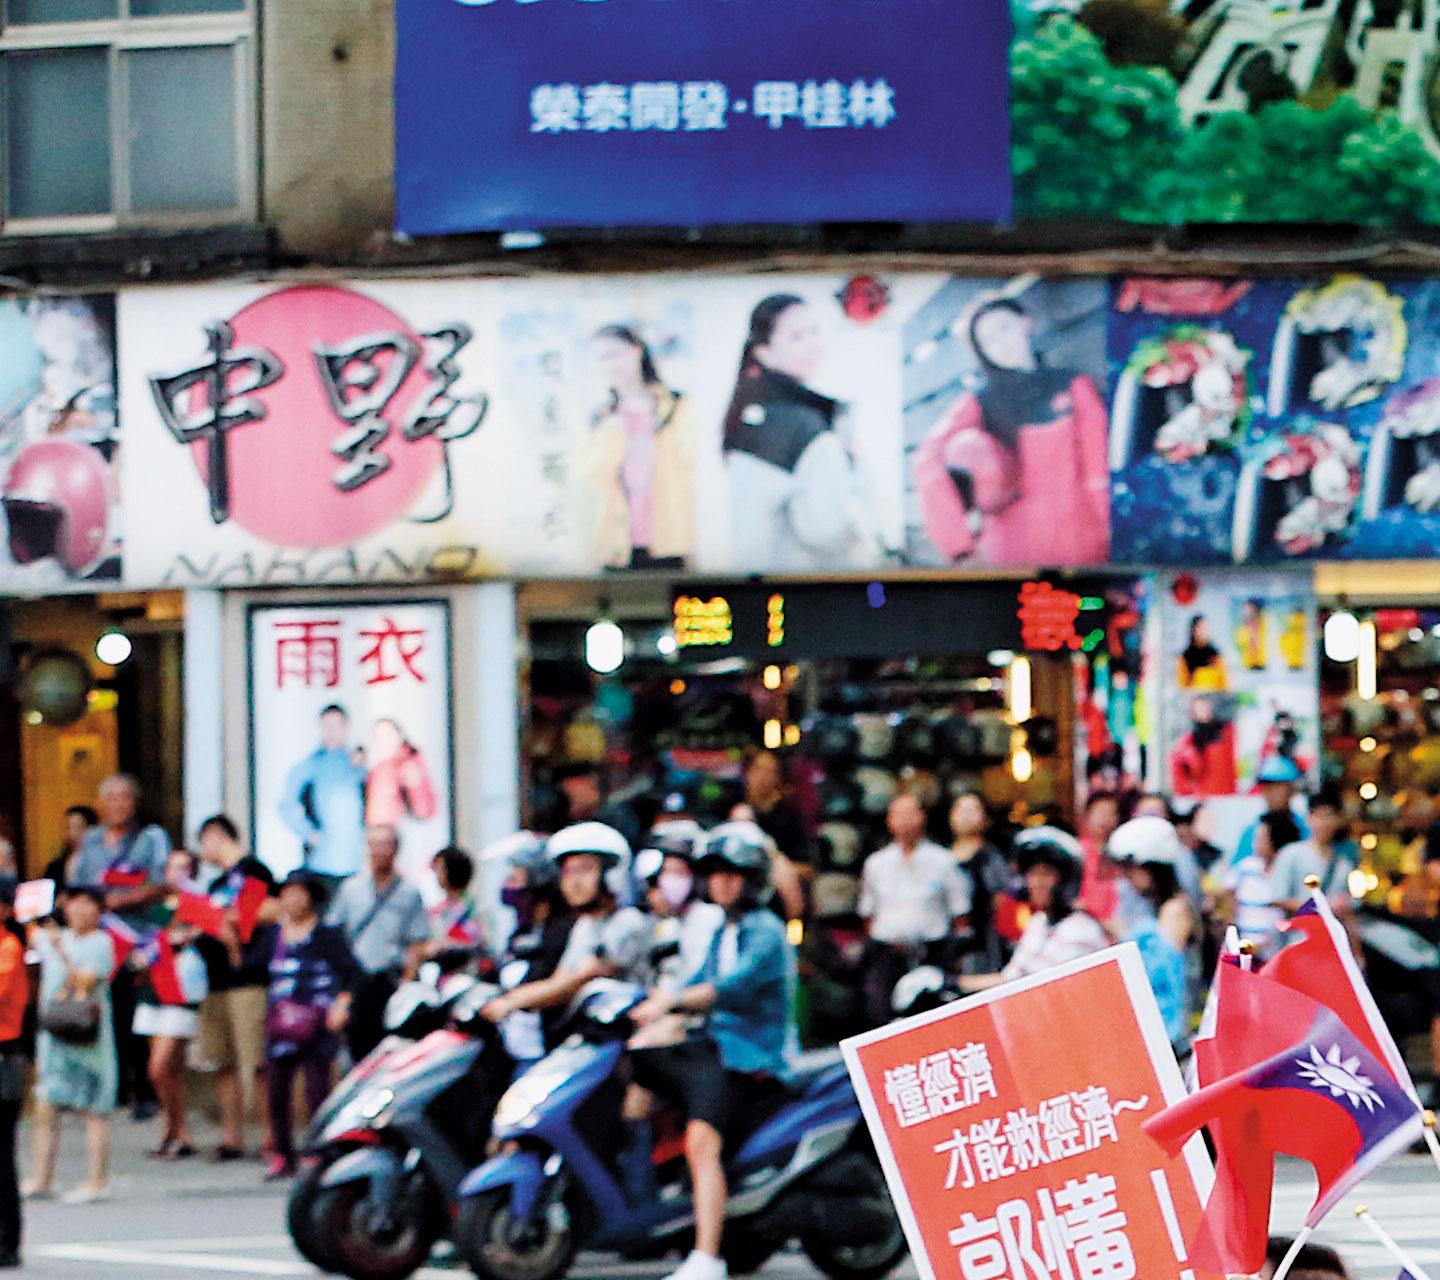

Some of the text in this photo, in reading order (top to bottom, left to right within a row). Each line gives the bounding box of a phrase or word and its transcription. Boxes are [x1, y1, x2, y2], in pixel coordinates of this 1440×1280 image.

[150, 318, 490, 525] 中野
[273, 617, 428, 690] 雨衣
[884, 1041, 1000, 1129] 懂經濟
